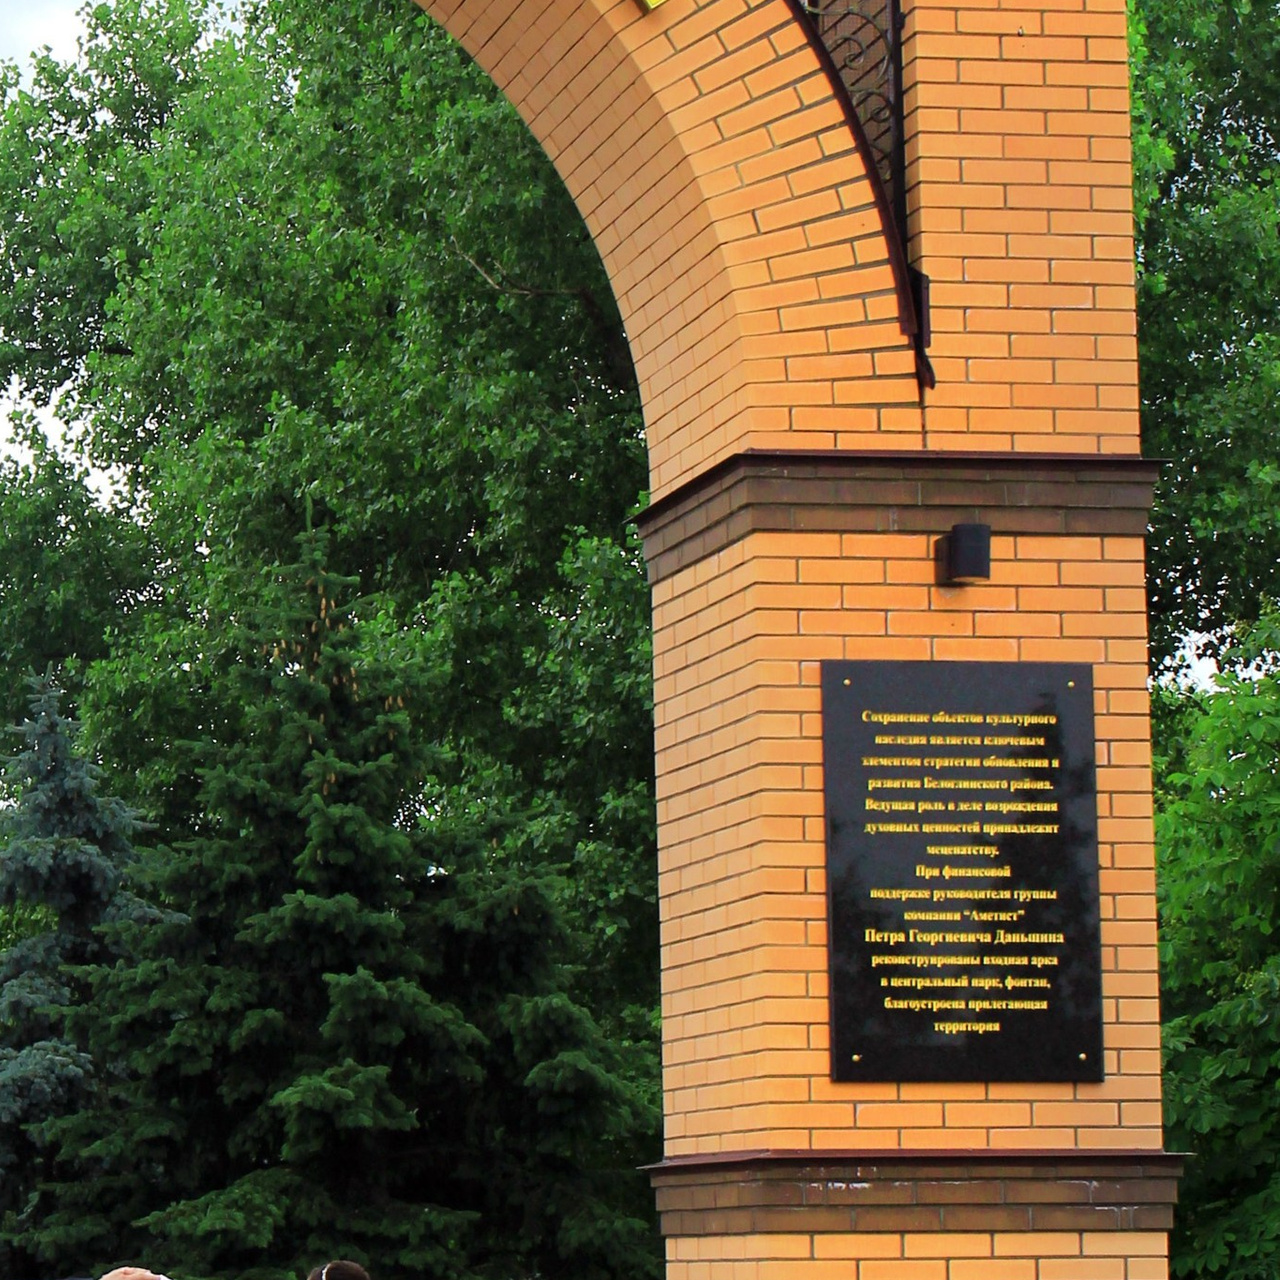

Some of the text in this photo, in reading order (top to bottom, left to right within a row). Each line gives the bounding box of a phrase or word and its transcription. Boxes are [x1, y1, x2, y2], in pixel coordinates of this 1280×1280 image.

[861, 710, 930, 726] Сохранение
[985, 714, 1057, 727] культурного
[874, 735, 1045, 747] наследия является ключевым
[922, 757, 981, 771] стратегии
[982, 755, 1049, 768] обновления
[1051, 759, 1059, 769] и
[867, 776, 1055, 793] развития Белоглинского района.
[865, 798, 1058, 815] Ведущая роль в деле возрождения
[864, 821, 1059, 837] духовных ценностей принадлежит
[926, 845, 1000, 858] меценатству.
[915, 865, 1011, 881] При финансовой
[870, 889, 1057, 903] поддержке руководителя группы
[903, 911, 962, 922] компании
[864, 929, 1064, 947] Петра Георгиевича Даньшина
[871, 955, 1058, 969] реконструированы входная арка
[880, 976, 1051, 991] в центральный парк, фонтан,
[884, 997, 1048, 1013] благоустроена прилегающая
[934, 1022, 1000, 1035] территория
